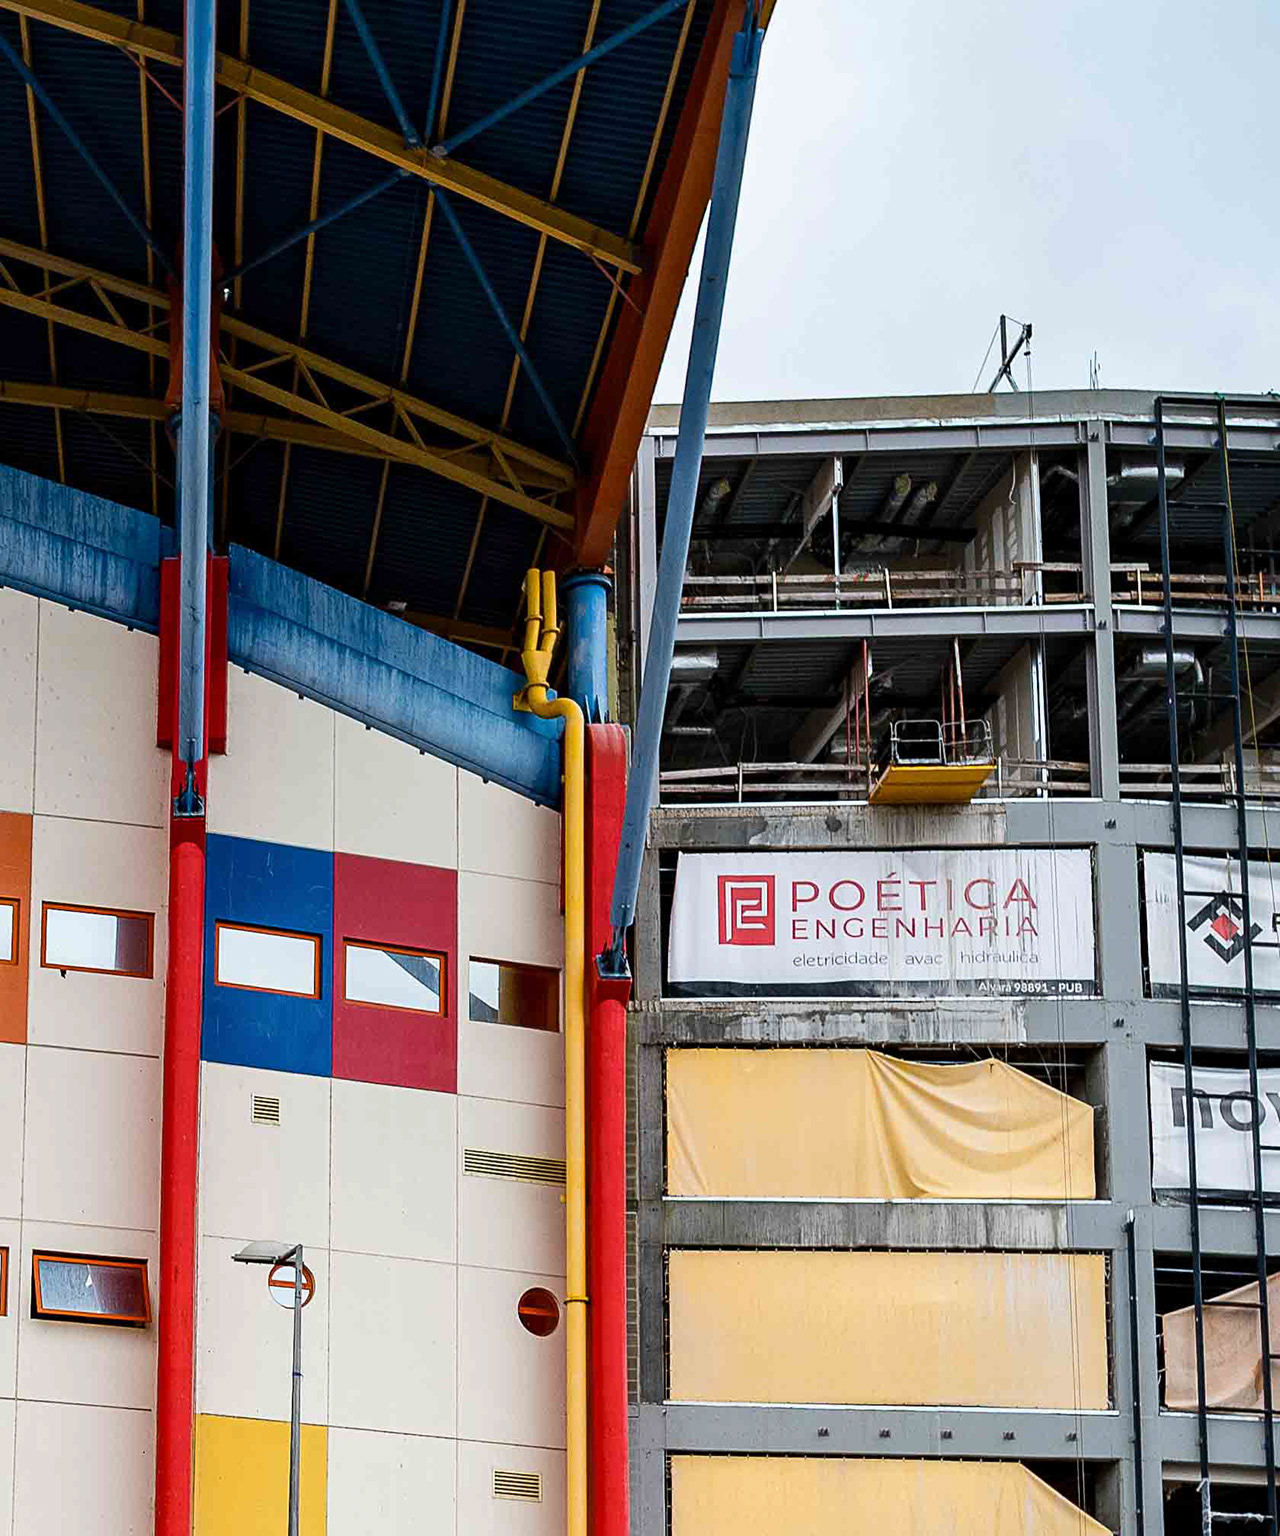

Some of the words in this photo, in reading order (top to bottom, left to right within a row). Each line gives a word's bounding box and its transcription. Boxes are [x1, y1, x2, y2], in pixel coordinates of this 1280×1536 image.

[791, 871, 1038, 912] POÉTICA
[792, 914, 1039, 940] ENGENHARIA
[792, 949, 889, 968] eletricidade
[1013, 981, 1049, 994] 98891
[1058, 982, 1083, 994] PUB
